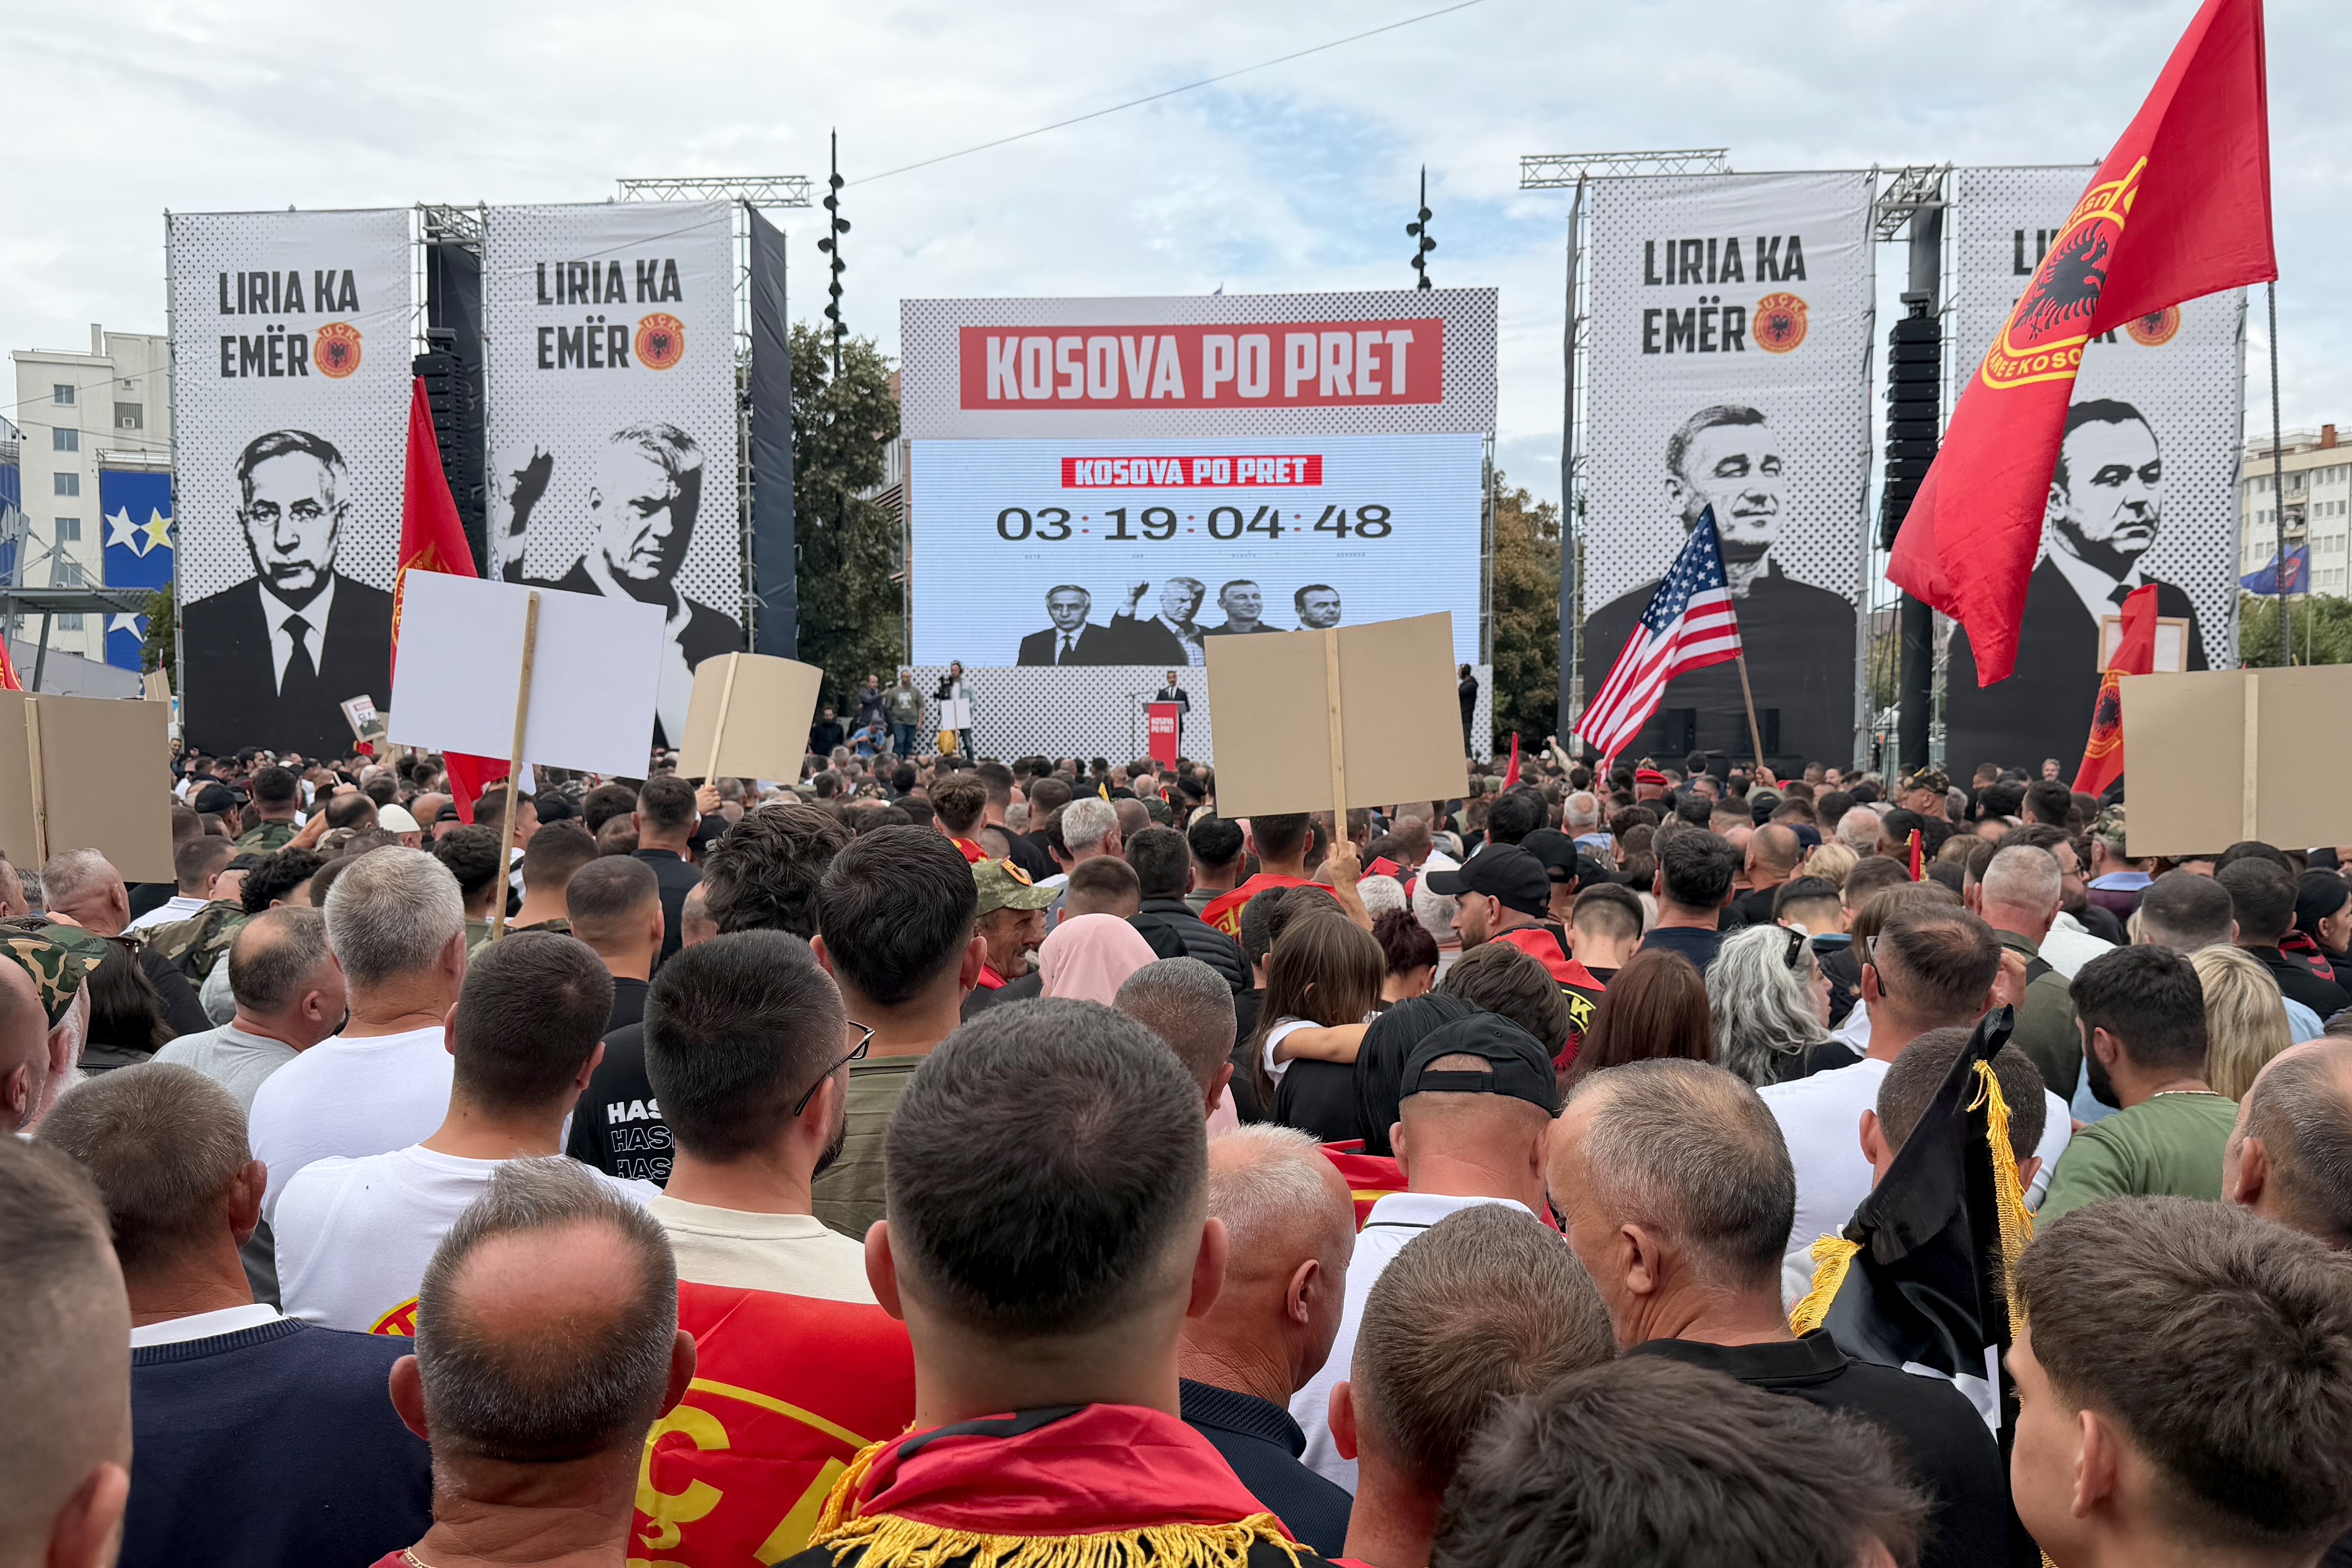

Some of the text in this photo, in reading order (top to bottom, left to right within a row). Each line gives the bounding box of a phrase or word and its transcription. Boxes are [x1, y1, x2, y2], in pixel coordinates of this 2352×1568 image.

[537, 259, 682, 305] LIRIA KA
[1644, 236, 1806, 285] LIRIA KA
[219, 270, 359, 314] LIRIA KA
[220, 324, 309, 377] EMËR
[538, 315, 629, 369] EMËR
[1643, 296, 1746, 354] EMËR
[986, 329, 1414, 400] KOSOVA PO PRET
[1075, 457, 1308, 485] KOSOVA PO PRET
